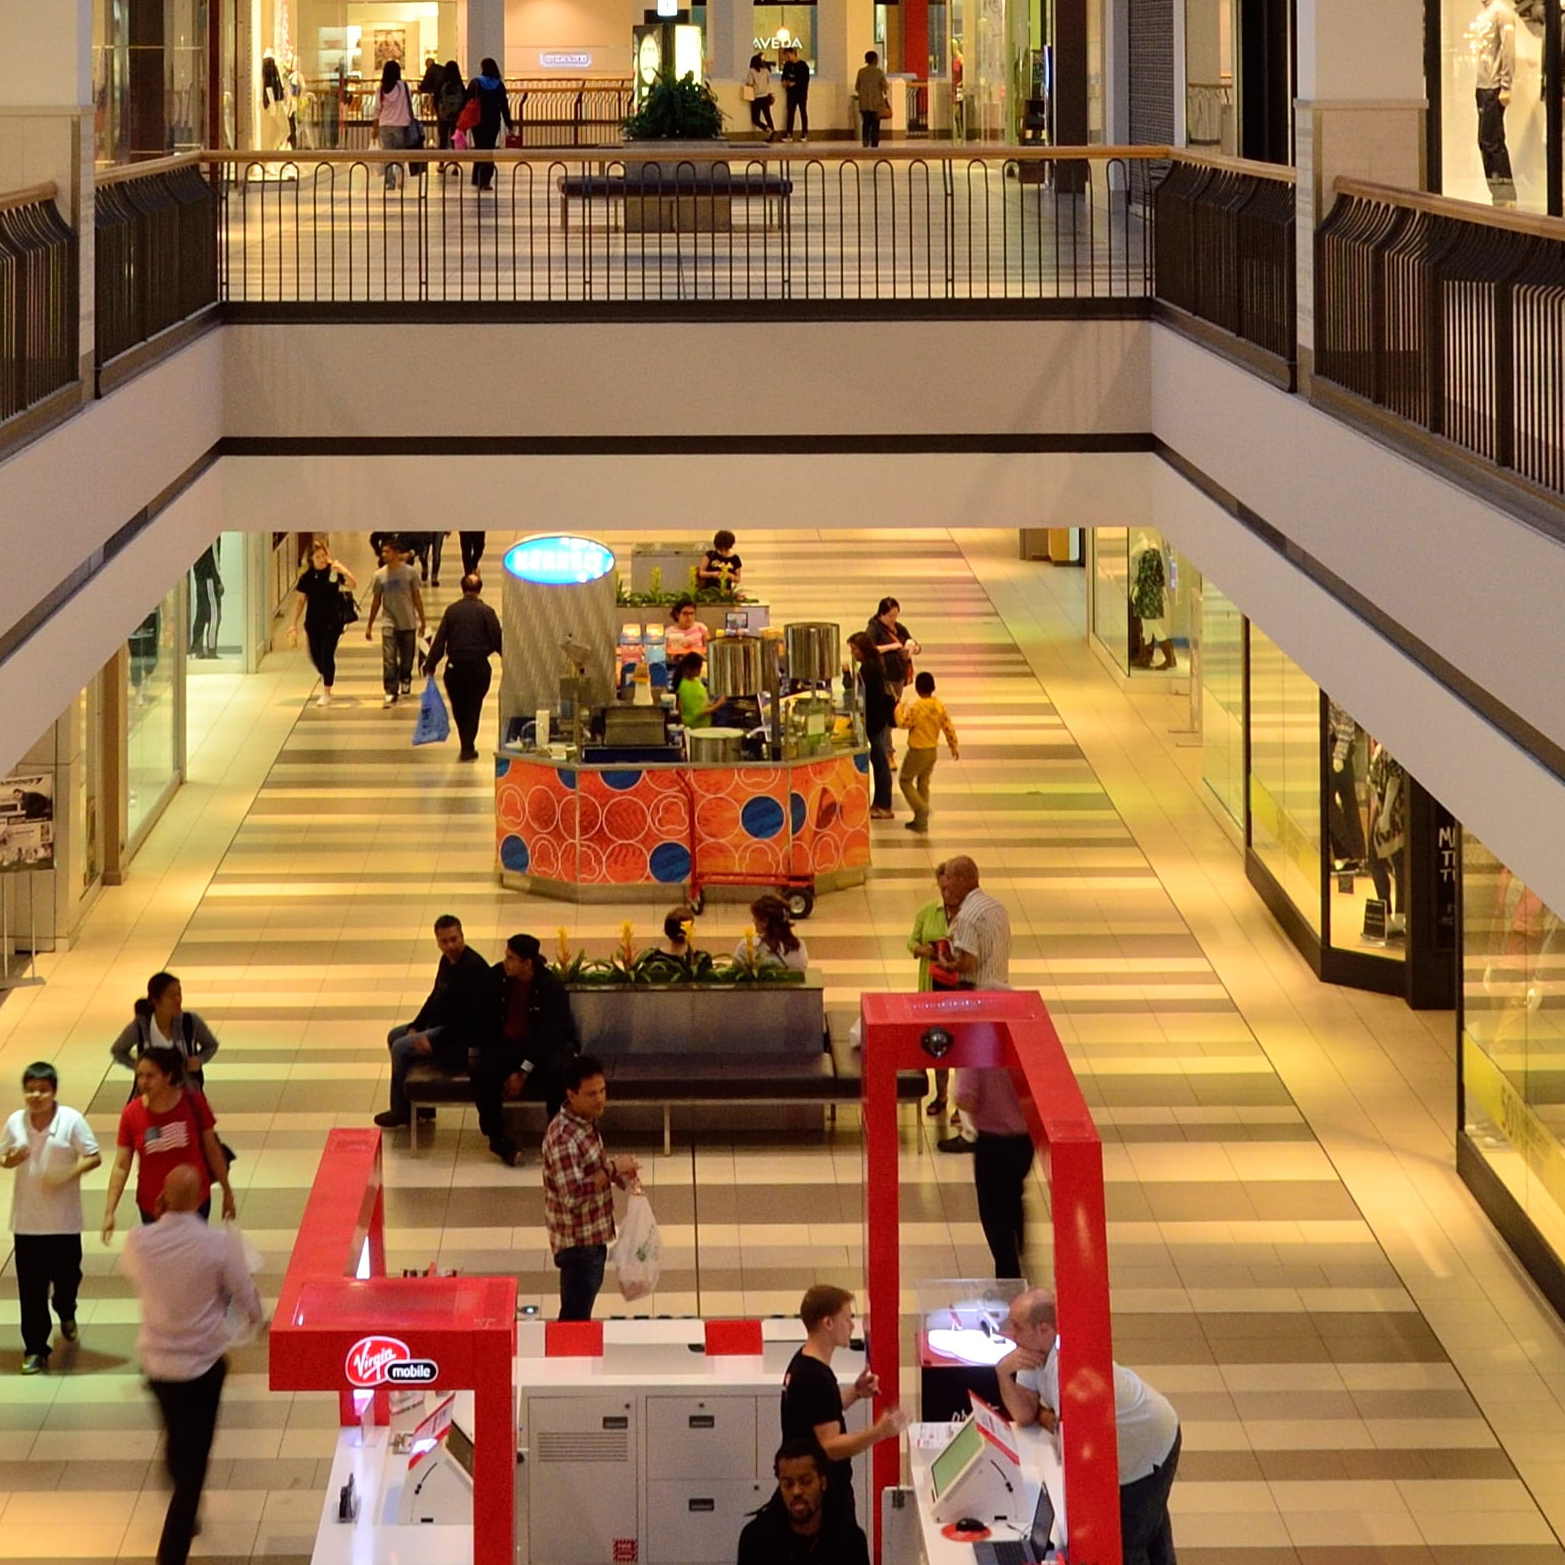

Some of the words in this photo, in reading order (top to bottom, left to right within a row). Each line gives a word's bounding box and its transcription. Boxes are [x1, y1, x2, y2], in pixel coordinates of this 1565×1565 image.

[753, 37, 803, 49] AVEDA
[353, 1340, 397, 1381] Virgin
[392, 1364, 431, 1378] mobile
